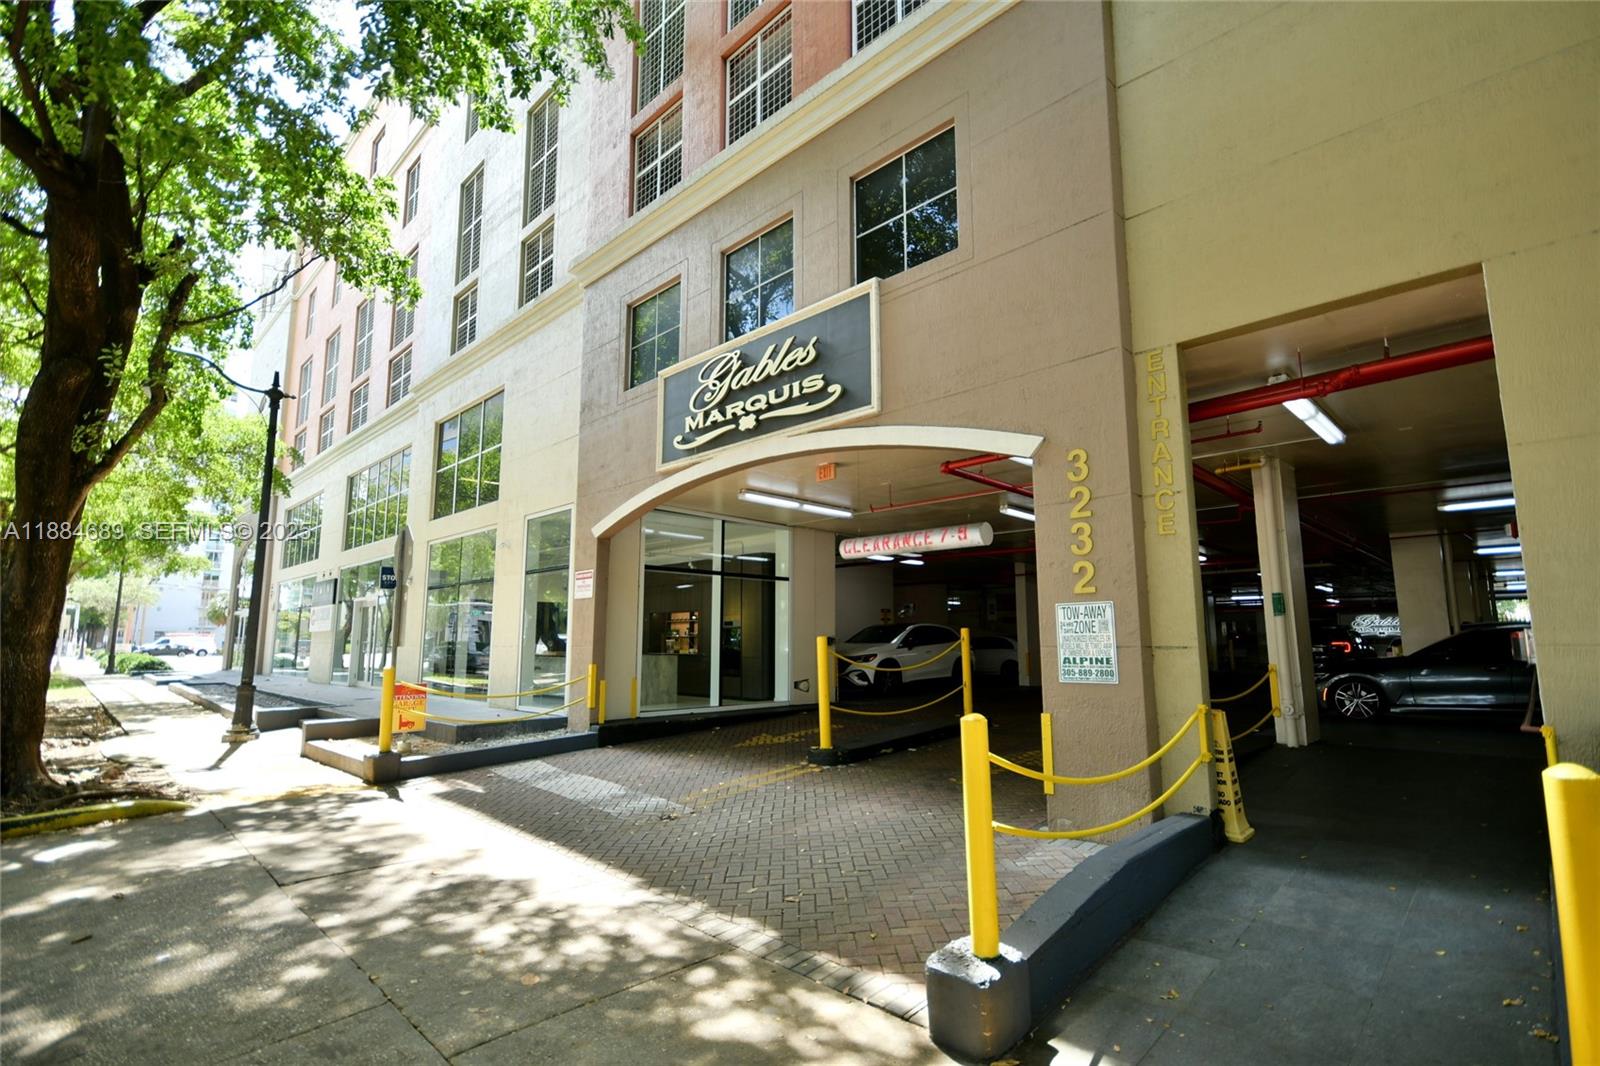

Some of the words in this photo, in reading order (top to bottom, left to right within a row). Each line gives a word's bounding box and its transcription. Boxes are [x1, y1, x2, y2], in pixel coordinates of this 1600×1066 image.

[689, 335, 819, 413] Gables
[684, 373, 826, 433] MARQUIS
[1148, 349, 1176, 537] ENTRANCE
[1066, 448, 1098, 595] 3232
[843, 529, 934, 554] CLEARANCE
[382, 574, 398, 582] STO
[1061, 606, 1107, 620] TOW-AWAY
[1074, 620, 1097, 634] ZONE
[1062, 656, 1113, 666] ALPINE
